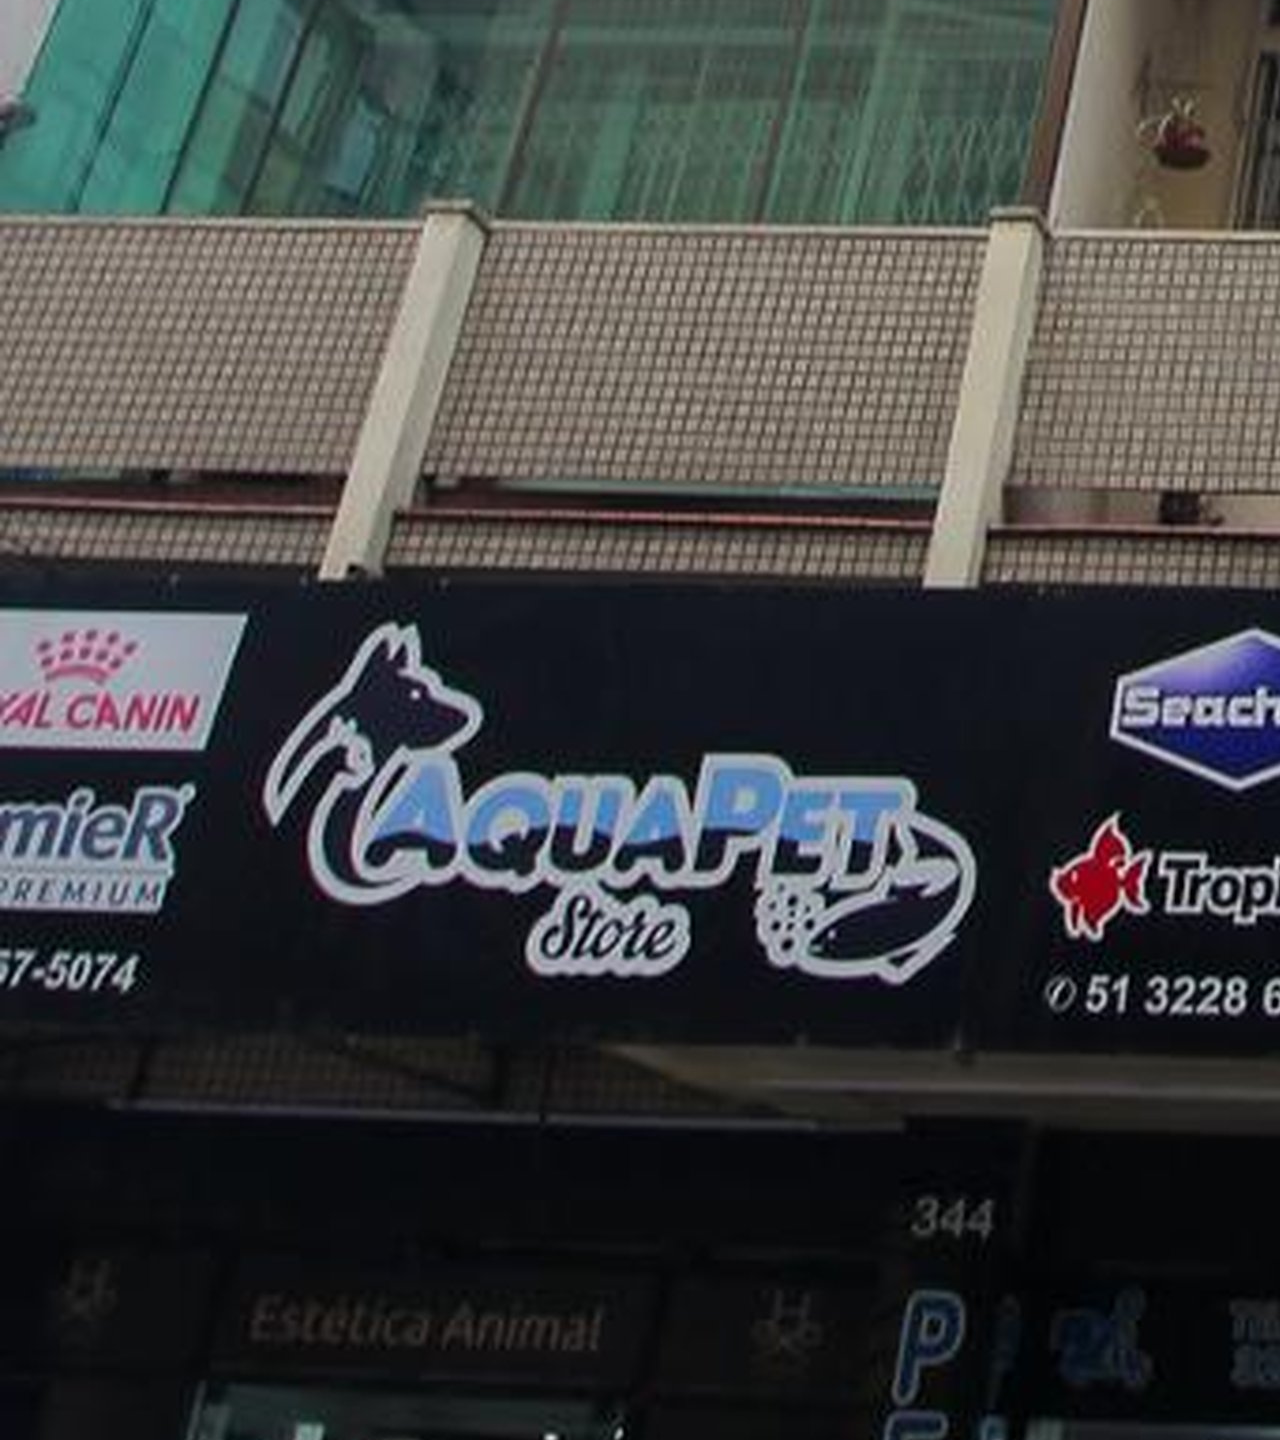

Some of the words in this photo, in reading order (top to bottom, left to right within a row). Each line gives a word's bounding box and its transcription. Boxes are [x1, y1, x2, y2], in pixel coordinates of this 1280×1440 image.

[66, 693, 200, 734] CANIN
[532, 888, 682, 966] Store
[1085, 974, 1130, 1013] 51
[1144, 975, 1249, 1015] 3228
[910, 1193, 995, 1242] 344
[440, 1297, 604, 1353] Animal
